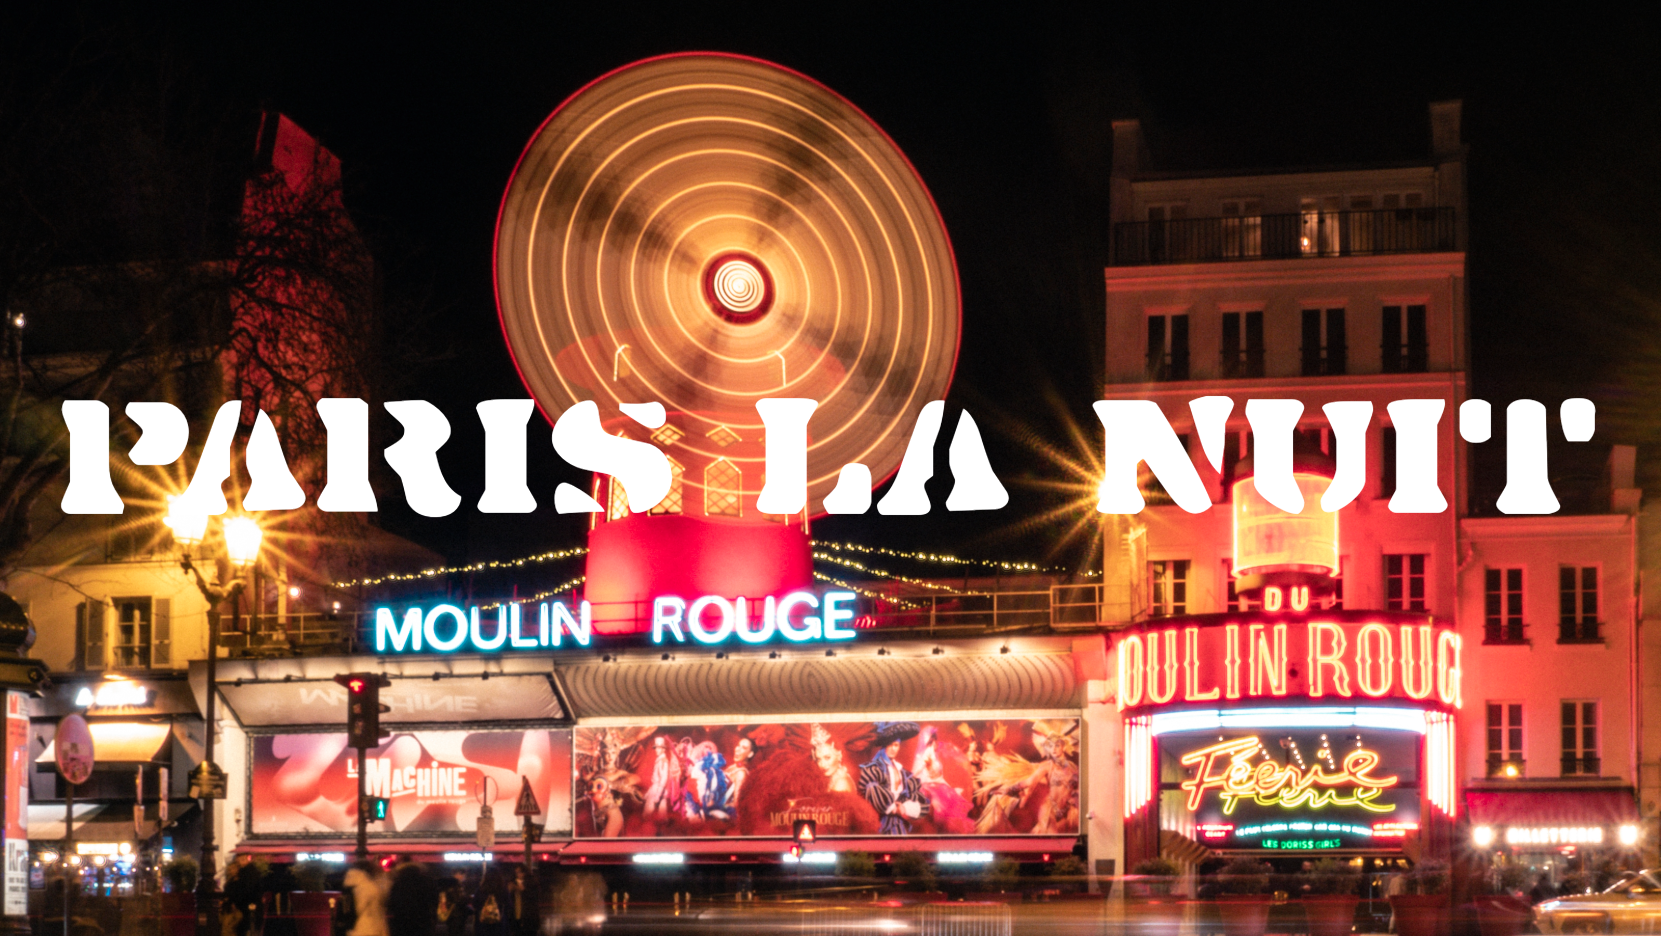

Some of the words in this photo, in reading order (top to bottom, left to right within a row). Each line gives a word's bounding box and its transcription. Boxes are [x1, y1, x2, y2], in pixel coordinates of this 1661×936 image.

[1264, 586, 1309, 611] DU
[374, 600, 592, 653] MOULIN
[652, 591, 857, 645] ROUGE
[1117, 624, 1288, 712] OULIN
[1308, 622, 1463, 709] ROUG
[812, 811, 850, 827] ROUGE
[1262, 838, 1279, 849] LES
[1280, 839, 1314, 850] DORISS
